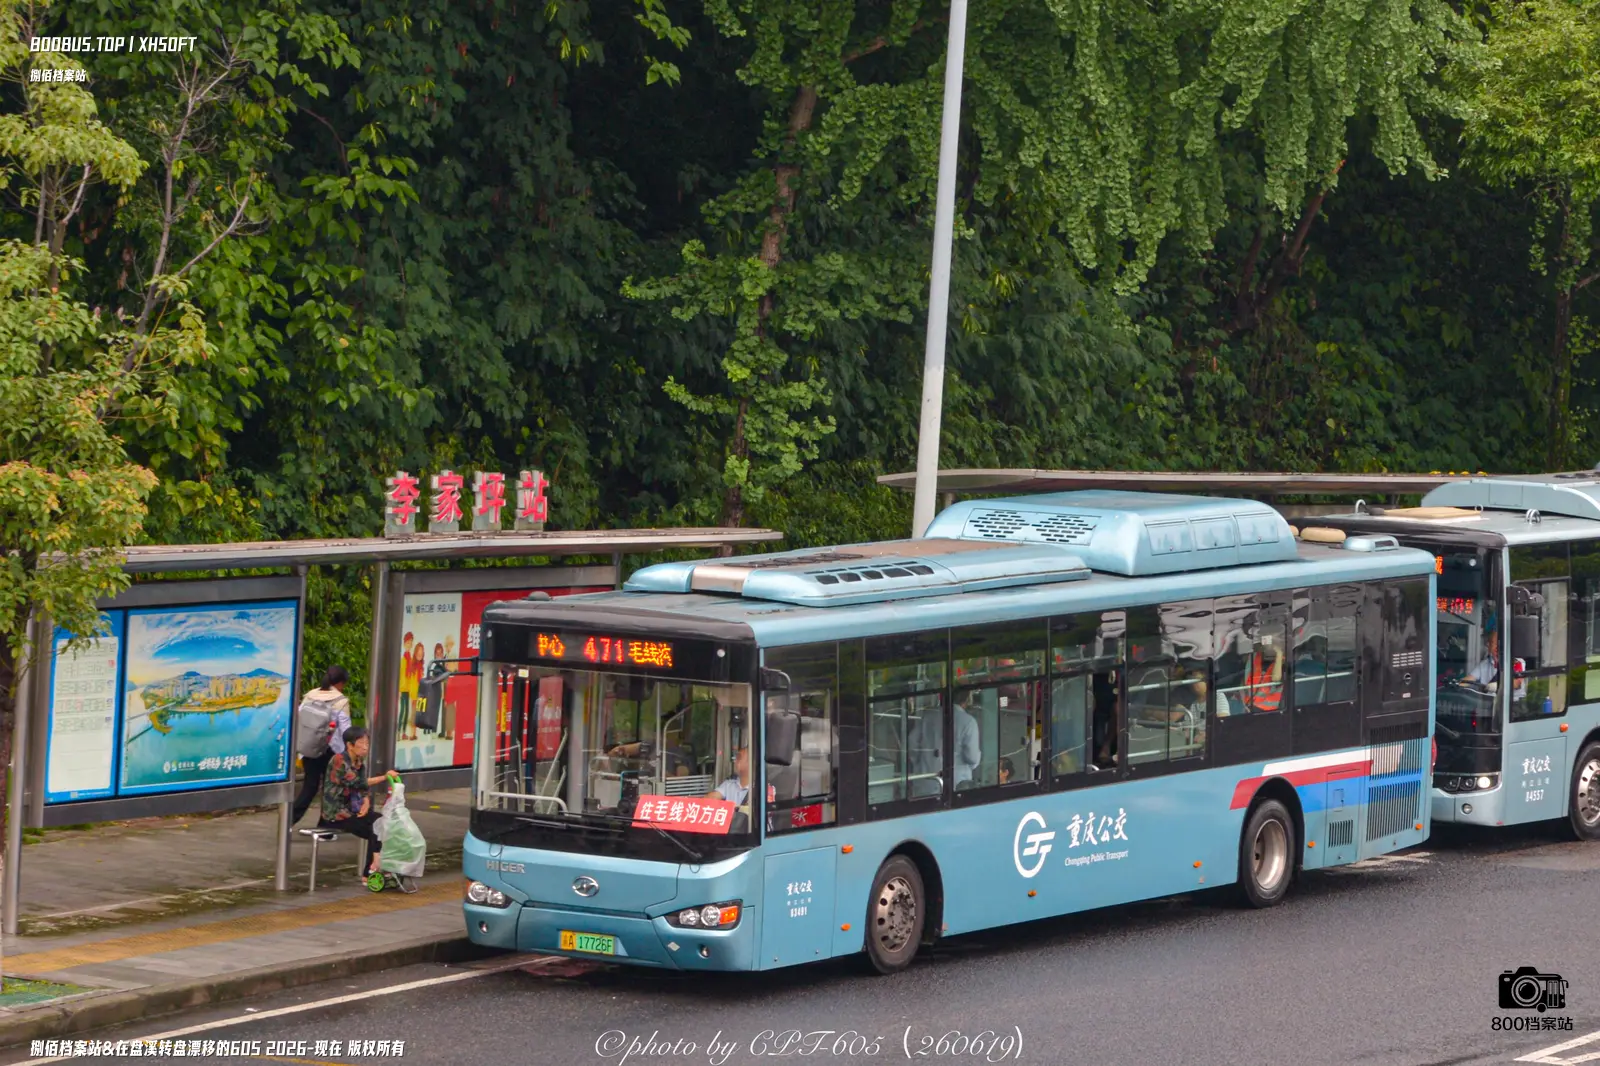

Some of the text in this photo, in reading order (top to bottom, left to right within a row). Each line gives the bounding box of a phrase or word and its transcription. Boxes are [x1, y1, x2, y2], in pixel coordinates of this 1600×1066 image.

[385, 469, 549, 525] 李家坪站
[584, 636, 624, 663] 471
[640, 800, 728, 826] 往毛线沟方向
[1066, 808, 1128, 848] 重庆公交
[486, 860, 525, 874] HIGER
[1091, 853, 1105, 863] Public
[1106, 850, 1129, 861] Transport
